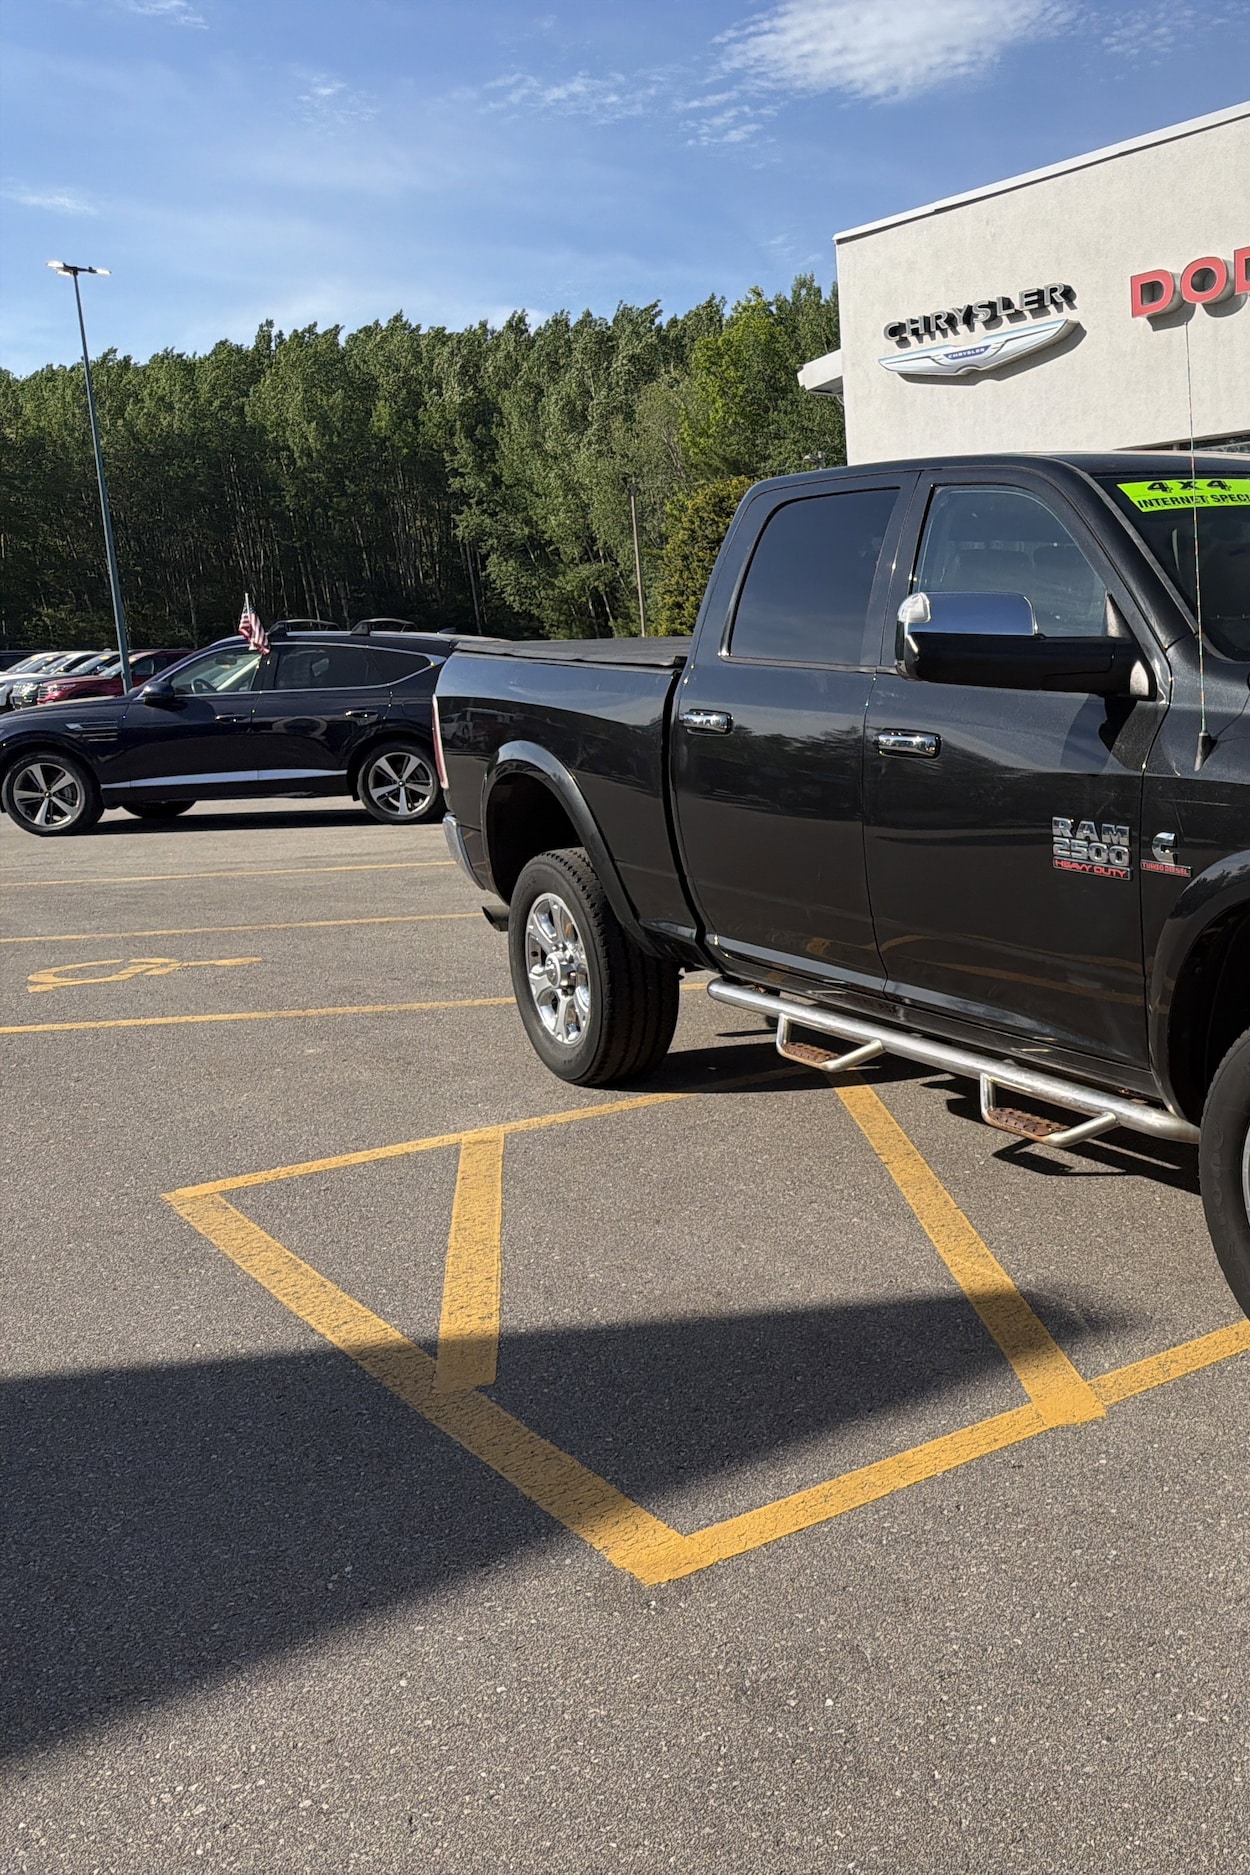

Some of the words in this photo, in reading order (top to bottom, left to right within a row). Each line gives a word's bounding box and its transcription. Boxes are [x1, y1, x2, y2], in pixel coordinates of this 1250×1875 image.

[883, 282, 1069, 341] CHRYSLER
[1137, 496, 1207, 508] INTERNET
[1052, 816, 1130, 846] RAM
[1052, 836, 1130, 867] 2500
[1055, 859, 1093, 873] HEAVY
[1094, 865, 1128, 878] DUTY
[1141, 861, 1164, 871] TURBO
[1164, 865, 1189, 876] DIESEL
